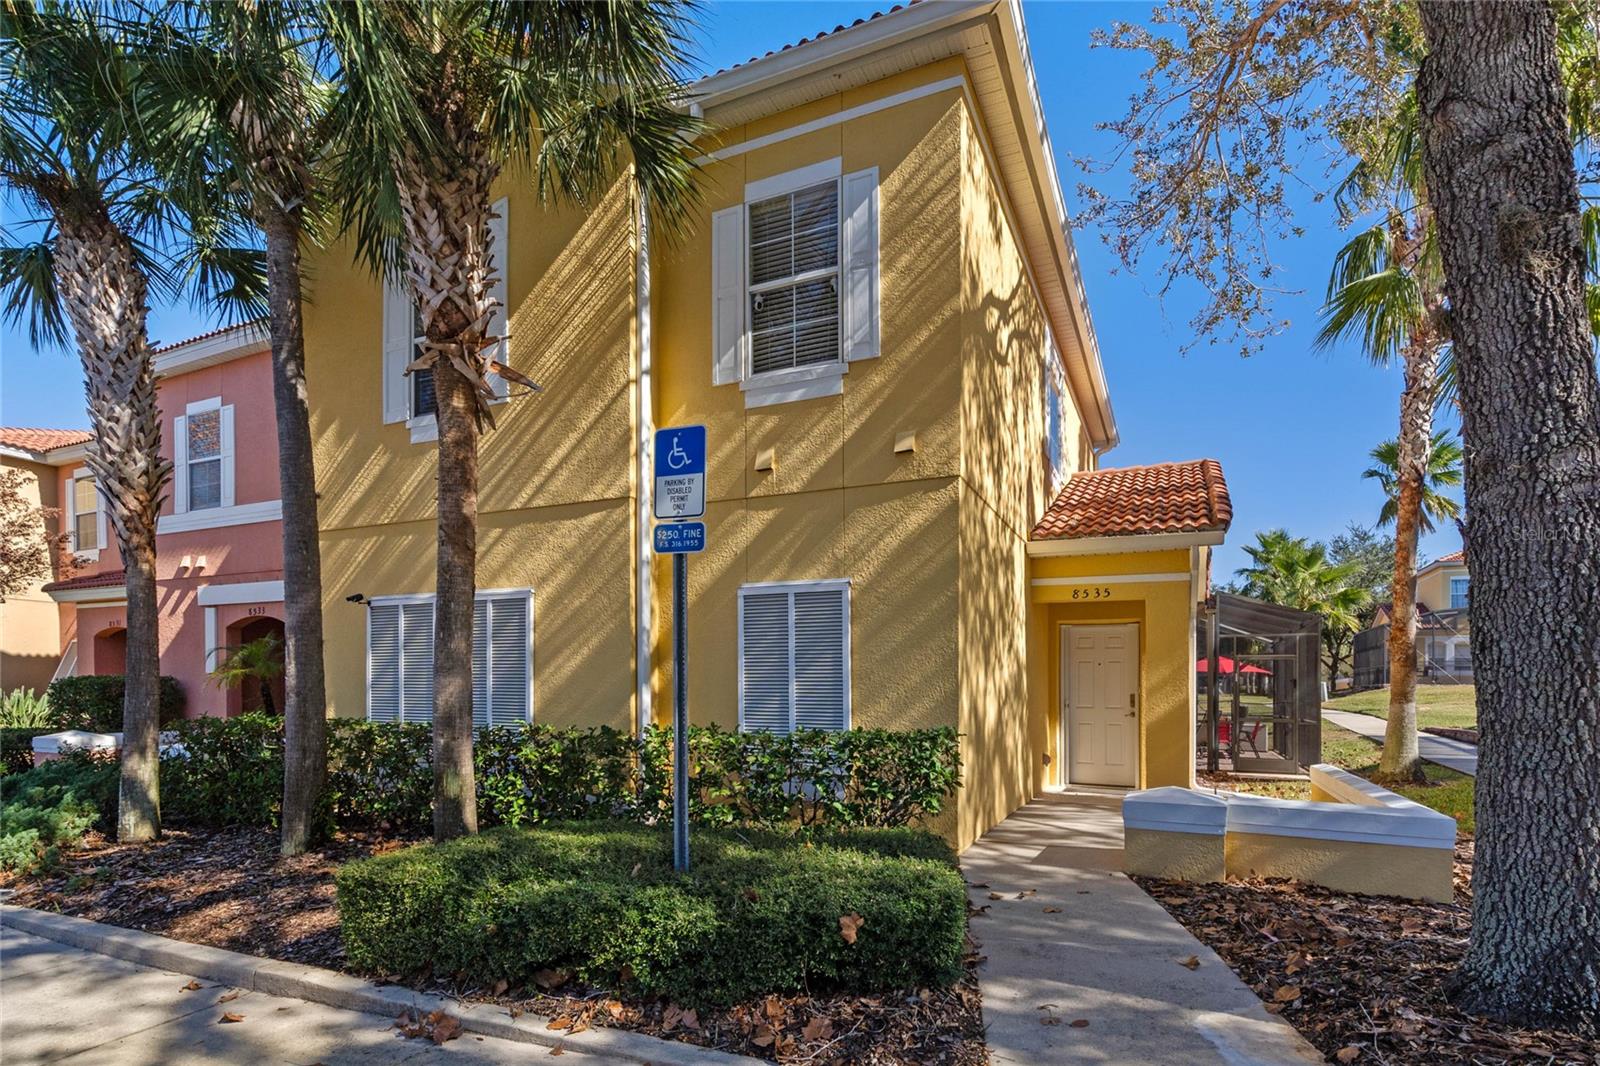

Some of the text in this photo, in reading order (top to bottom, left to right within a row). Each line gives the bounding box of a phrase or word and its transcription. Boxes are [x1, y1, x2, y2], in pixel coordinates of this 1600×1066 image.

[664, 479, 686, 487] PARKING
[667, 486, 692, 495] DISABLED
[673, 503, 685, 511] ONLY
[683, 528, 701, 538] FINE
[1072, 587, 1110, 599] 8535
